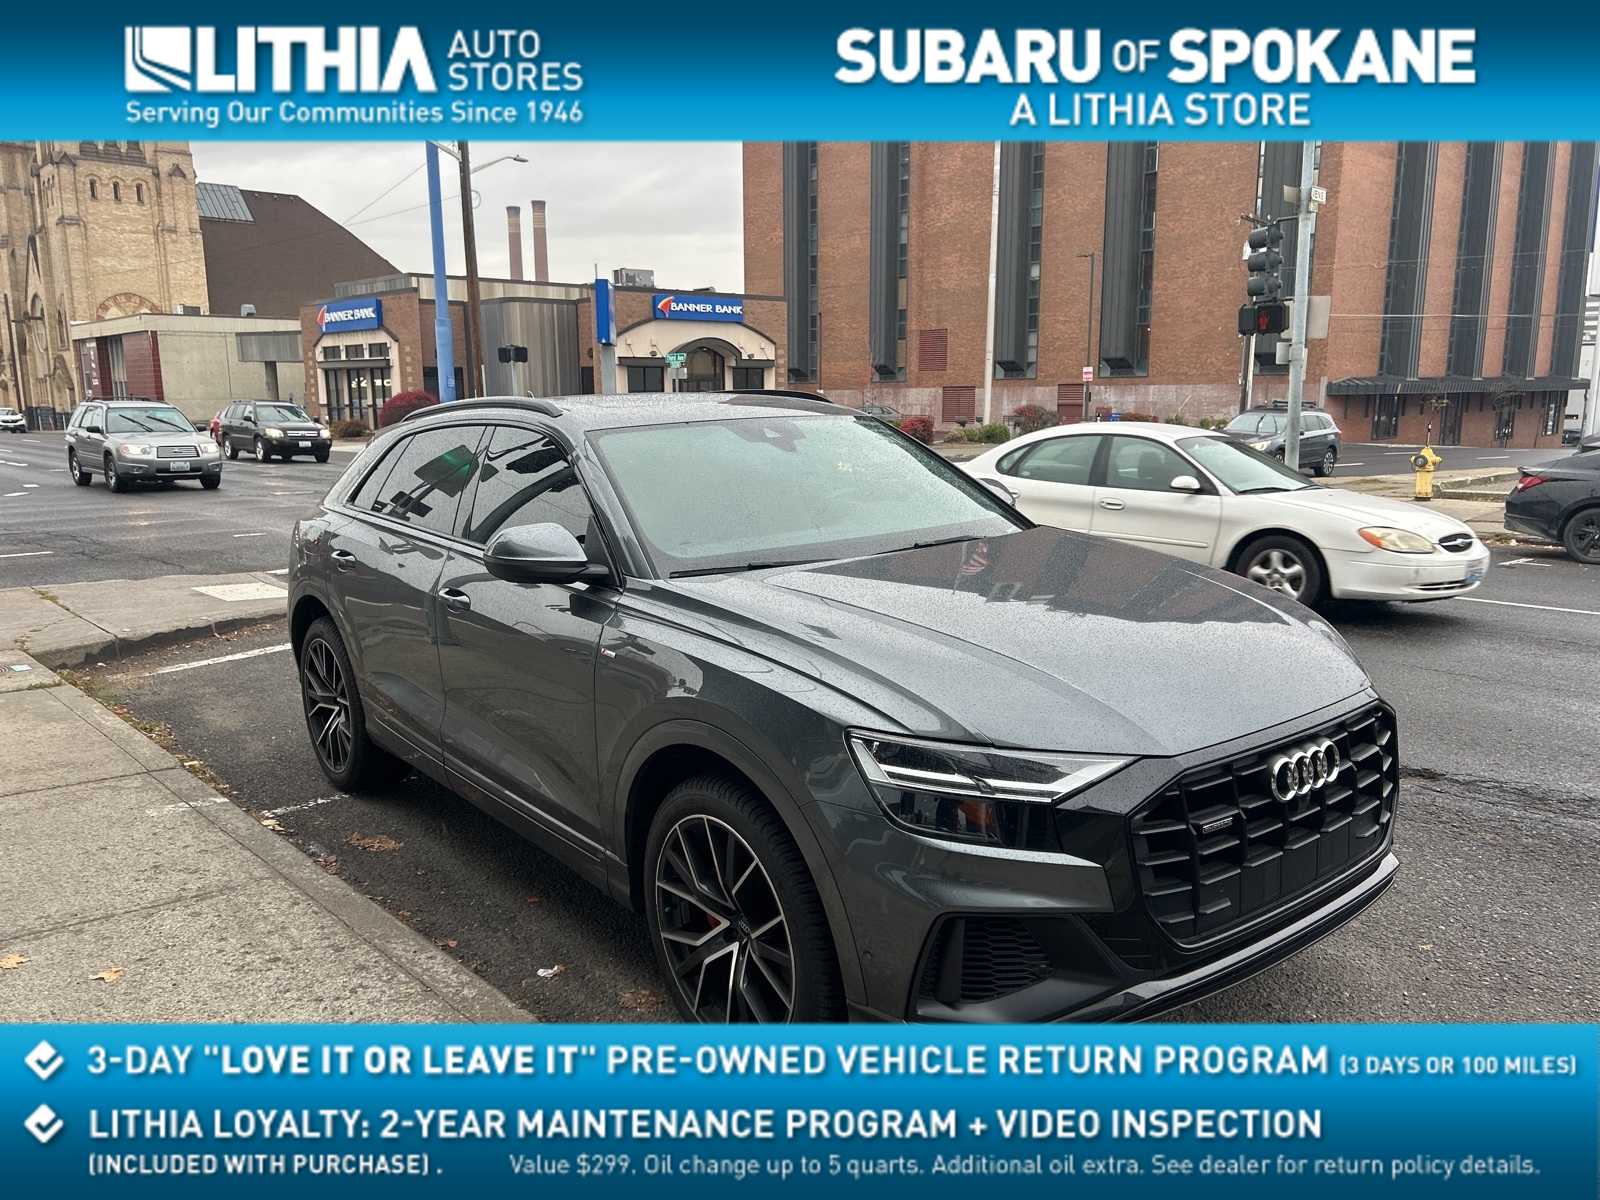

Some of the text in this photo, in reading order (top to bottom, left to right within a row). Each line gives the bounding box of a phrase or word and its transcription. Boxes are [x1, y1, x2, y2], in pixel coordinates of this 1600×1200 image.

[671, 303, 743, 314] BANNER BANK
[325, 308, 377, 323] BANNER BANK
